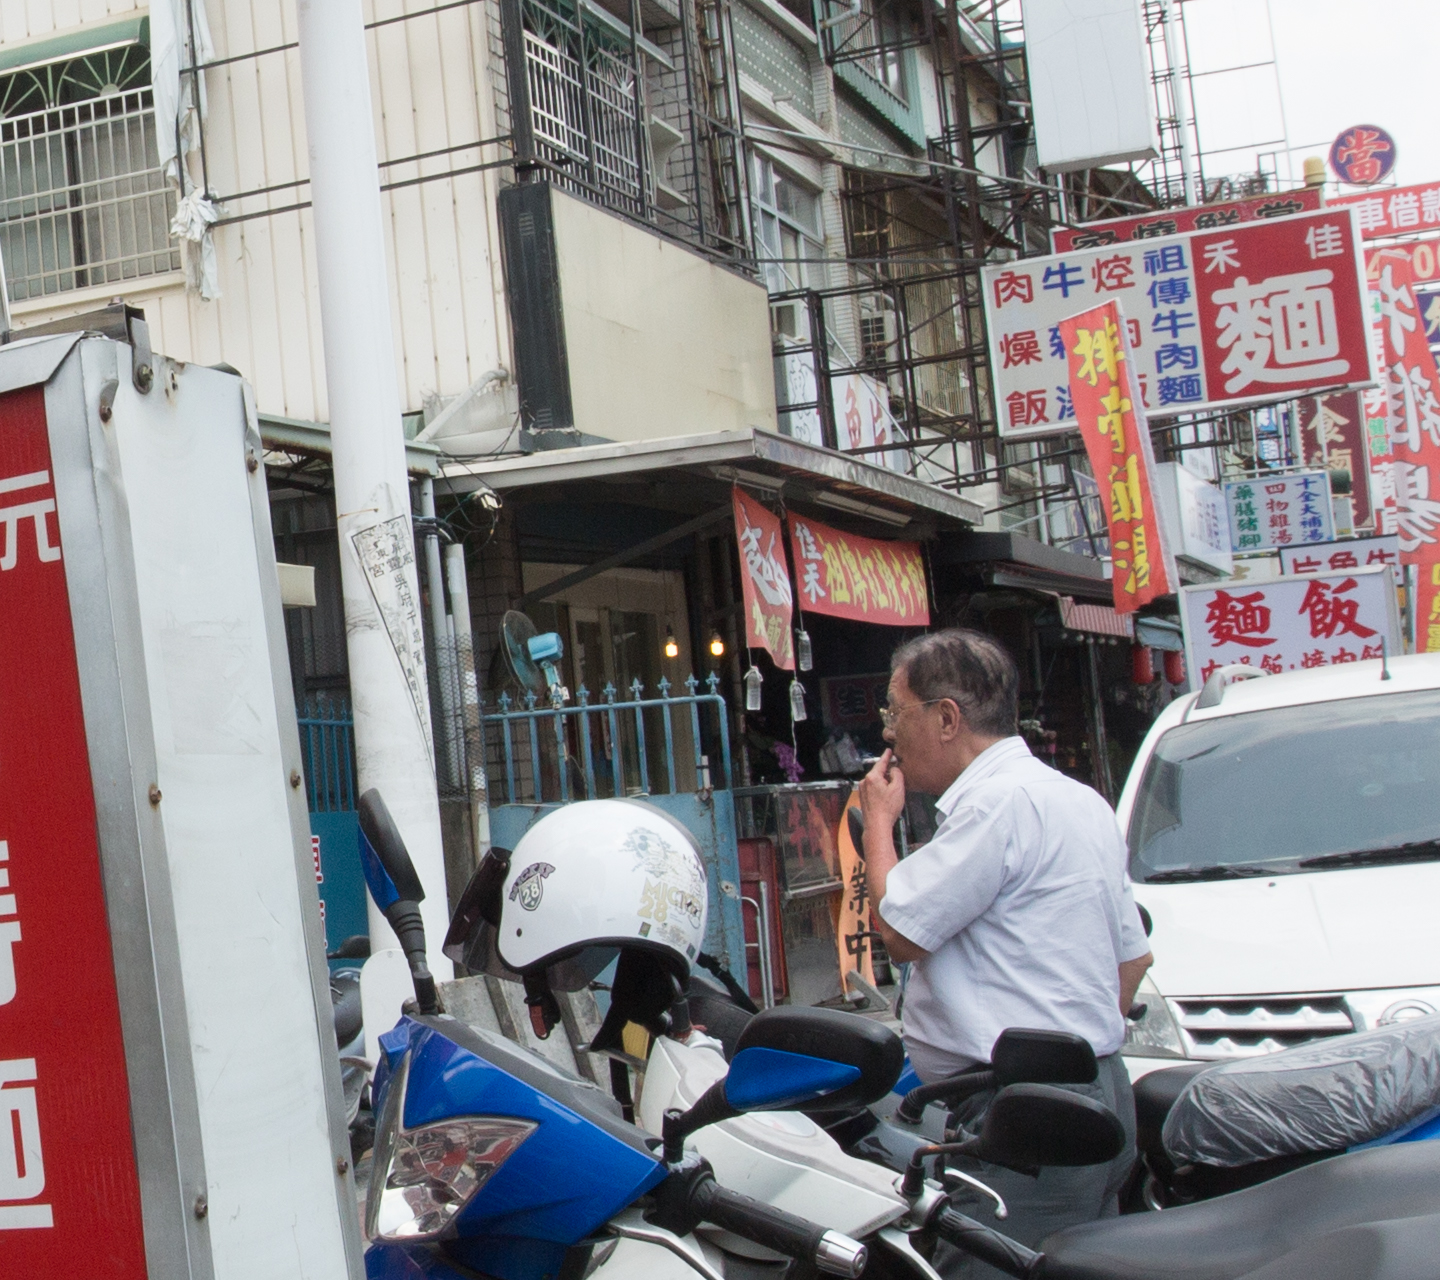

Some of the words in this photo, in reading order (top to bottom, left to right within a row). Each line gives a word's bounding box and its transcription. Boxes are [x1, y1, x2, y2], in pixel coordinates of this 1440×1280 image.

[1337, 128, 1391, 184] 當
[992, 270, 1051, 428] 肉燥飯
[1142, 243, 1204, 408] 祖傳牛肉麵
[1210, 268, 1351, 395] 麵
[1264, 482, 1294, 545] 四物雞湯
[1295, 477, 1323, 542] 十全大補湯
[521, 882, 541, 904] 28
[636, 893, 669, 924] 28
